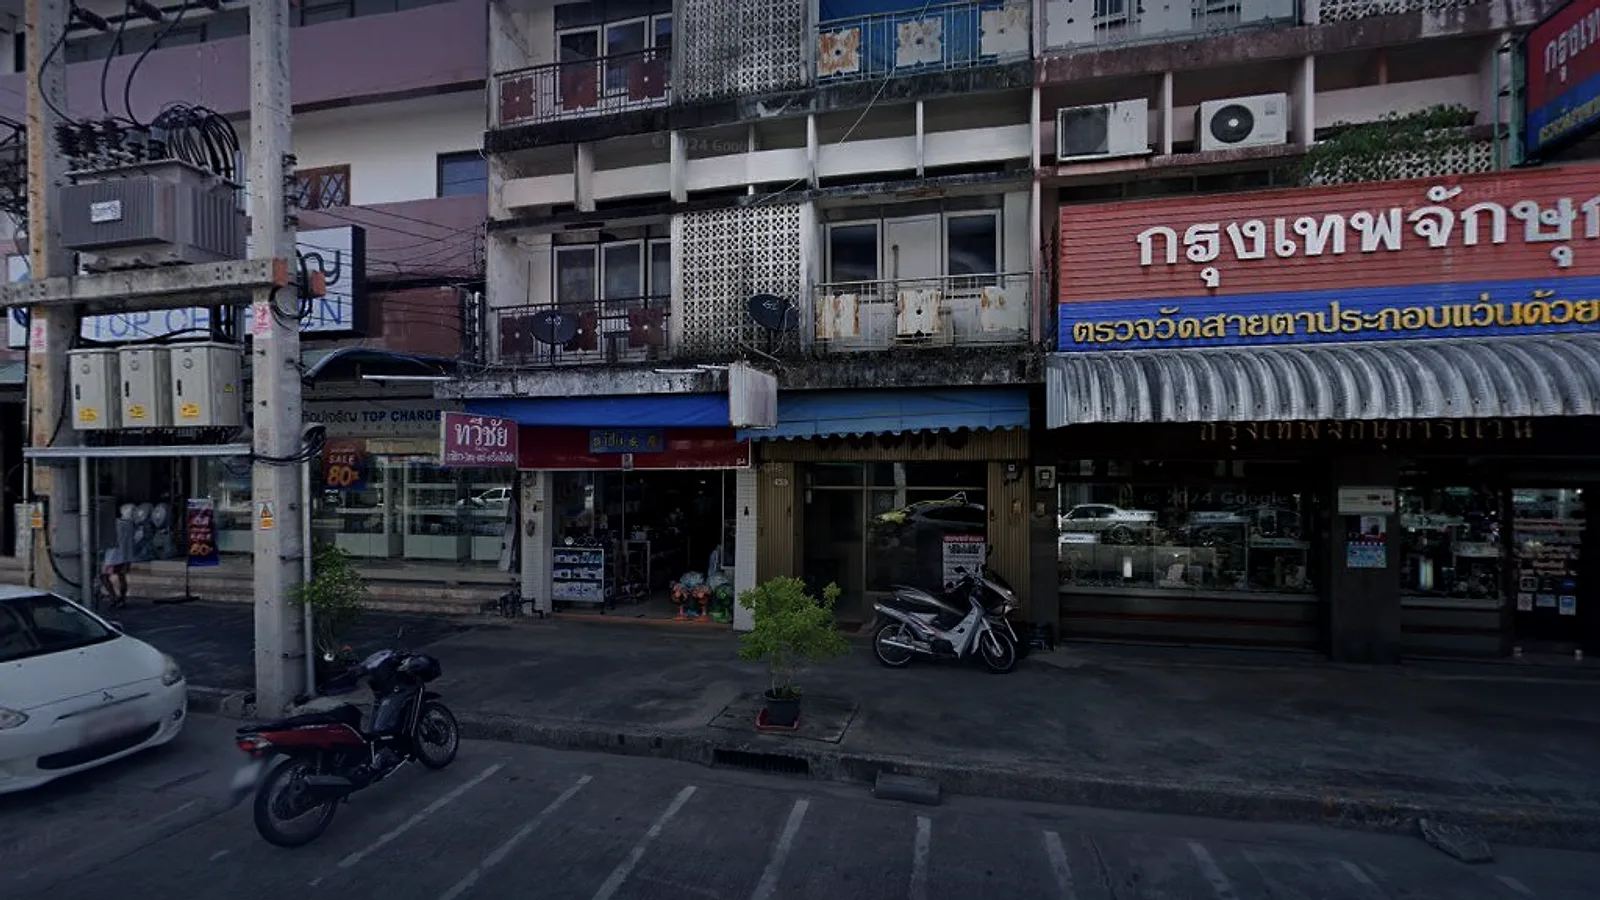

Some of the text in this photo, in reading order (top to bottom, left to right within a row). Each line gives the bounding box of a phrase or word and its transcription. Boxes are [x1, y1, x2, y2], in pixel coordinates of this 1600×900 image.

[362, 411, 386, 422] TOP
[454, 417, 508, 447] ทวีชัย
